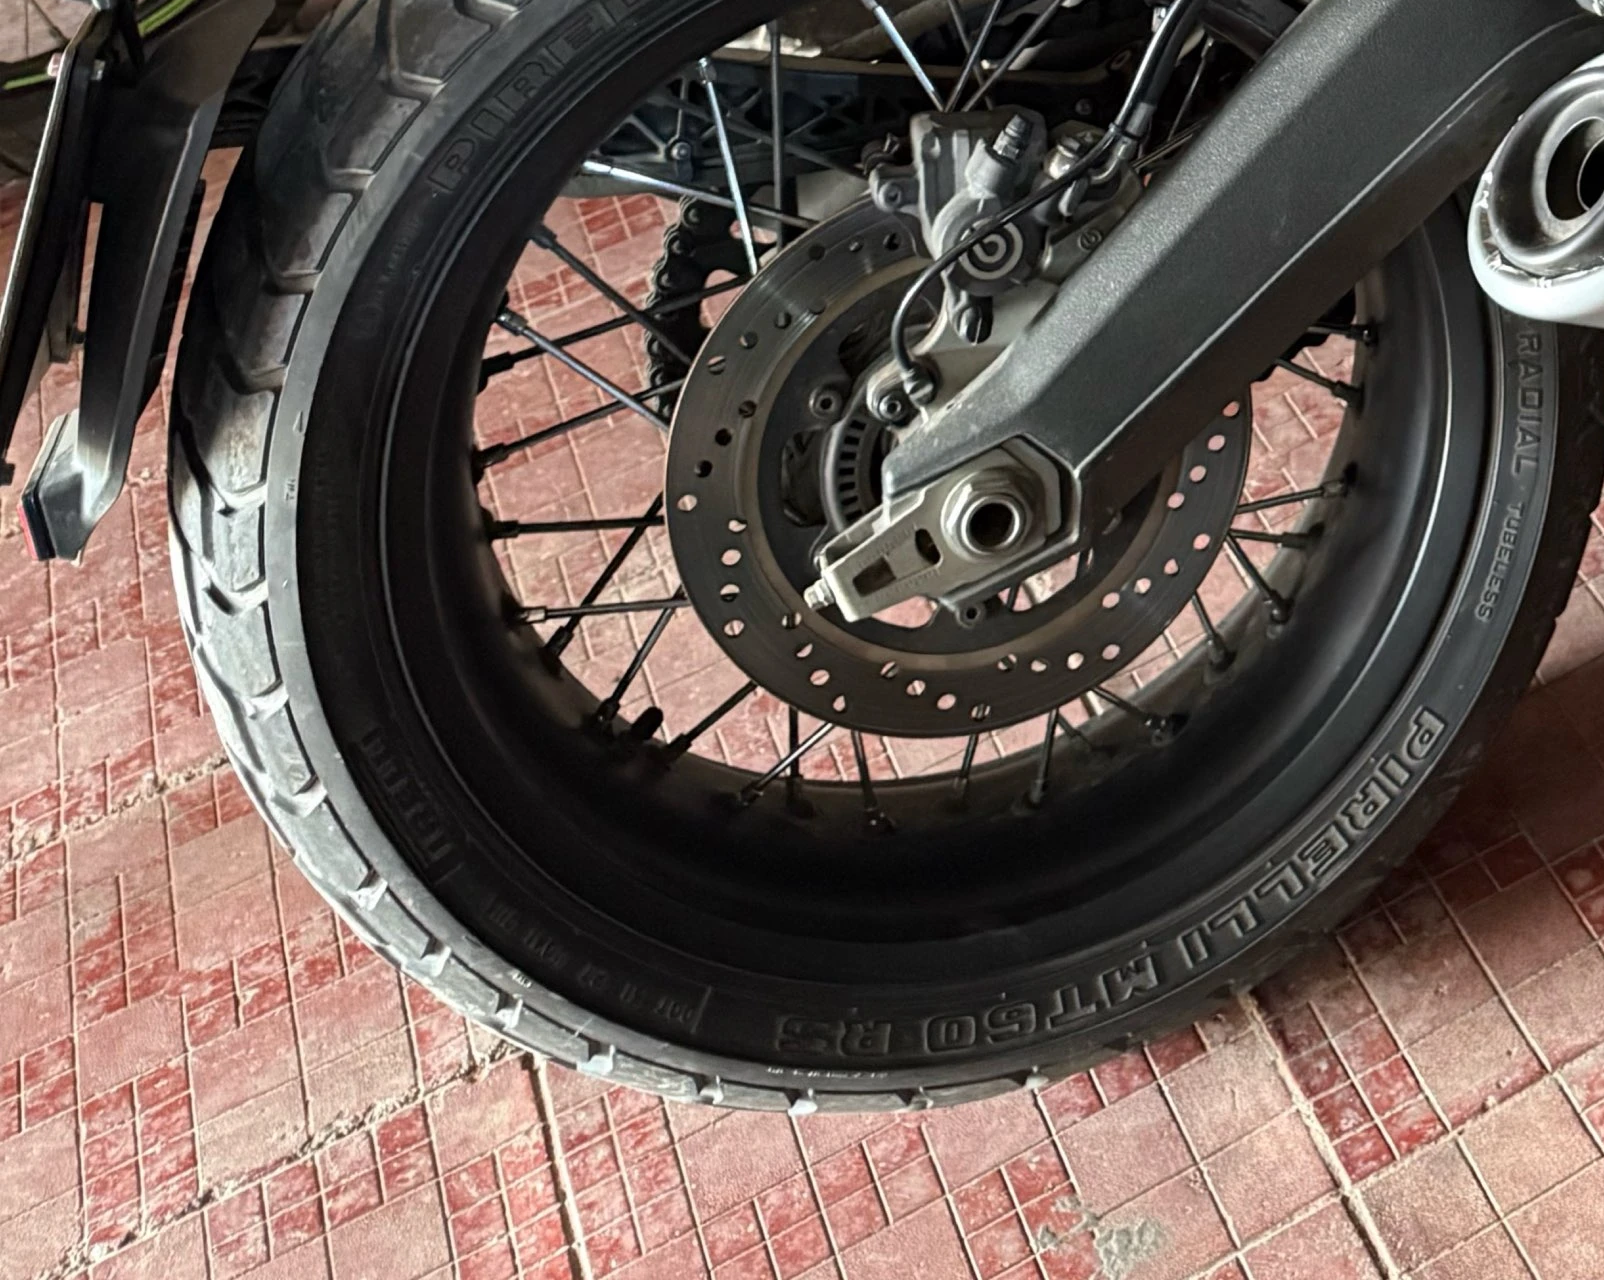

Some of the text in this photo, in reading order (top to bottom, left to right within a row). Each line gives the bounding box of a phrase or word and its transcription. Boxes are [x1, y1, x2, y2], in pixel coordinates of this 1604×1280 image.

[1510, 332, 1544, 477] RADIAL
[1176, 704, 1448, 970] PIRELLI
[922, 954, 1160, 1055] MT60
